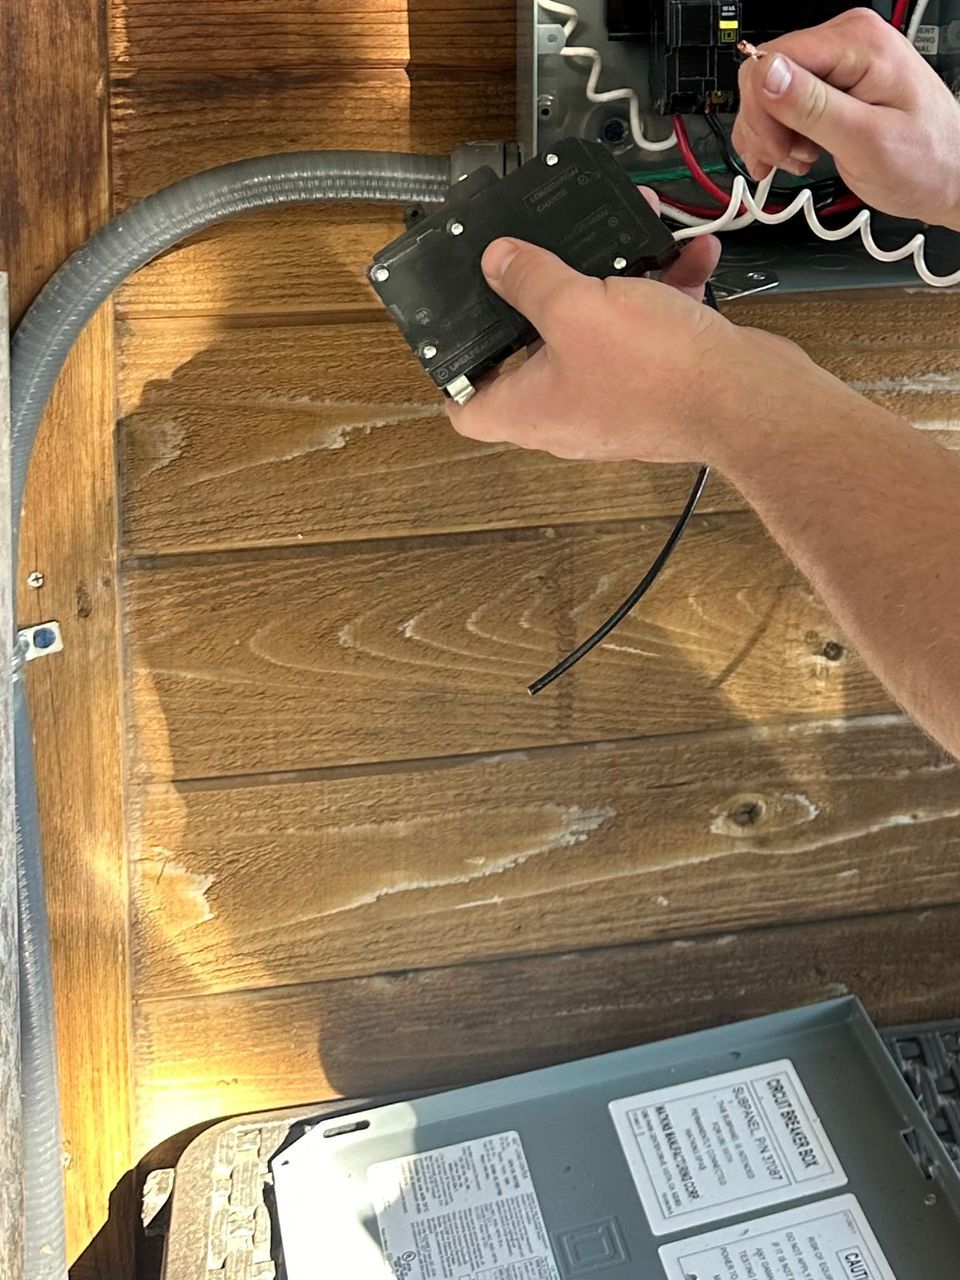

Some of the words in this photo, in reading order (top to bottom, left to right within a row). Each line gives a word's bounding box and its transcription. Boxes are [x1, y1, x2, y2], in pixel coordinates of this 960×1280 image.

[764, 1077, 792, 1110] CIRCUIT
[779, 1109, 811, 1150] BREAKER
[796, 1148, 819, 1169] BOX
[664, 1130, 693, 1182] MANUFACTURING
[705, 1148, 728, 1186] CONNECTED
[784, 1231, 796, 1242] DO
[789, 1242, 802, 1256] NOT
[806, 1236, 820, 1251] RISK
[813, 1251, 824, 1261] OF
[717, 1246, 734, 1270] POWER
[737, 1250, 757, 1278] TESTING
[780, 1262, 793, 1278] NOT
[796, 1256, 812, 1278] APPLY
[843, 1251, 870, 1280] CAUT
